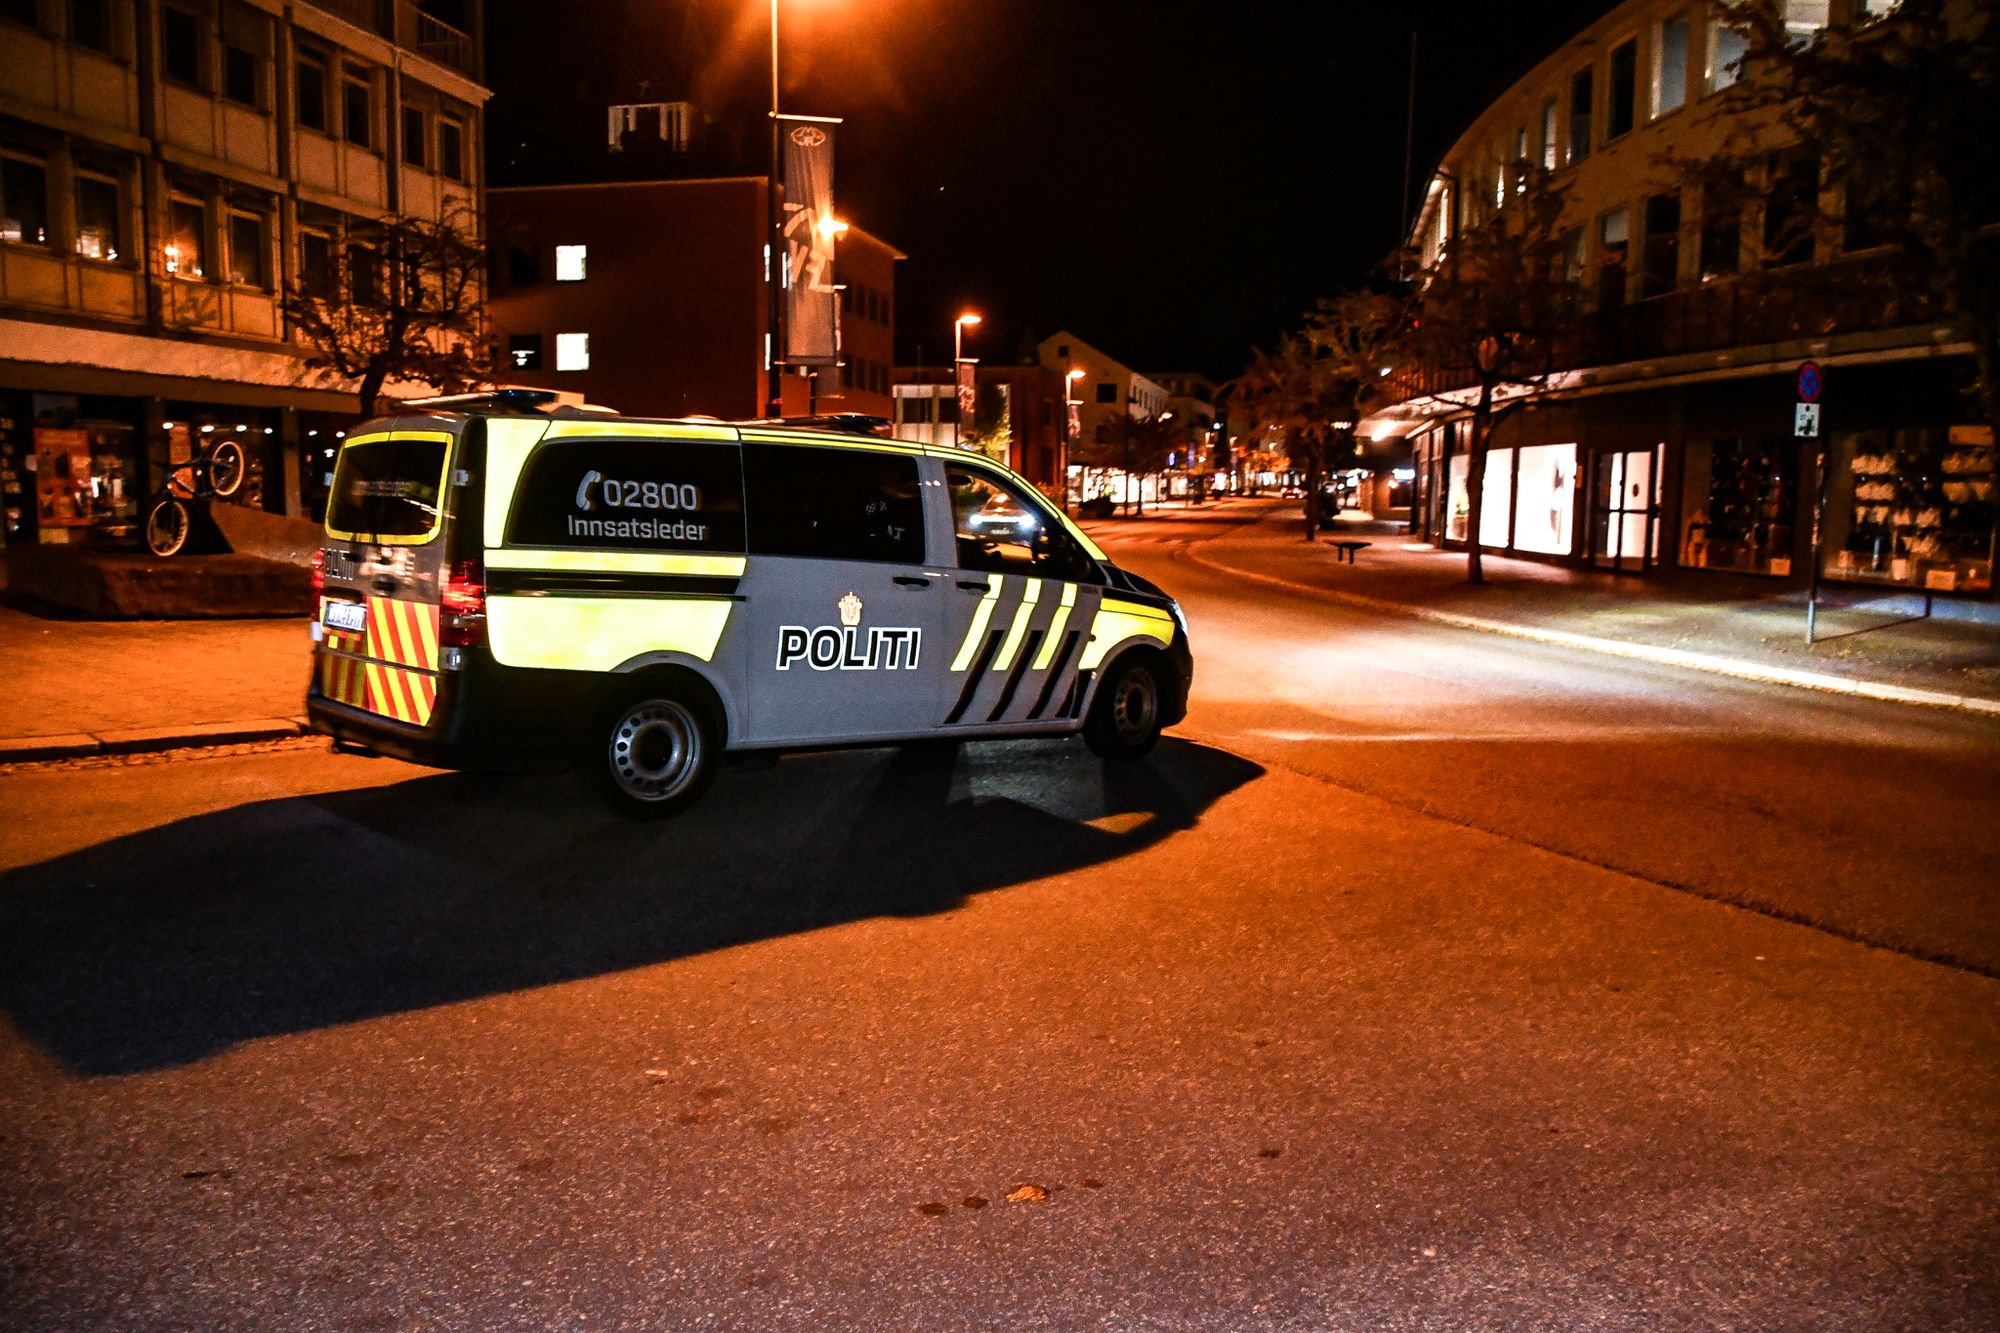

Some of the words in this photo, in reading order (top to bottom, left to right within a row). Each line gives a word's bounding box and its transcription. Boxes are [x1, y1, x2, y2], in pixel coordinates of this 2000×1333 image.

[603, 479, 697, 511] 02800
[567, 514, 706, 540] Innsatsleder
[775, 625, 922, 671] POLITI
